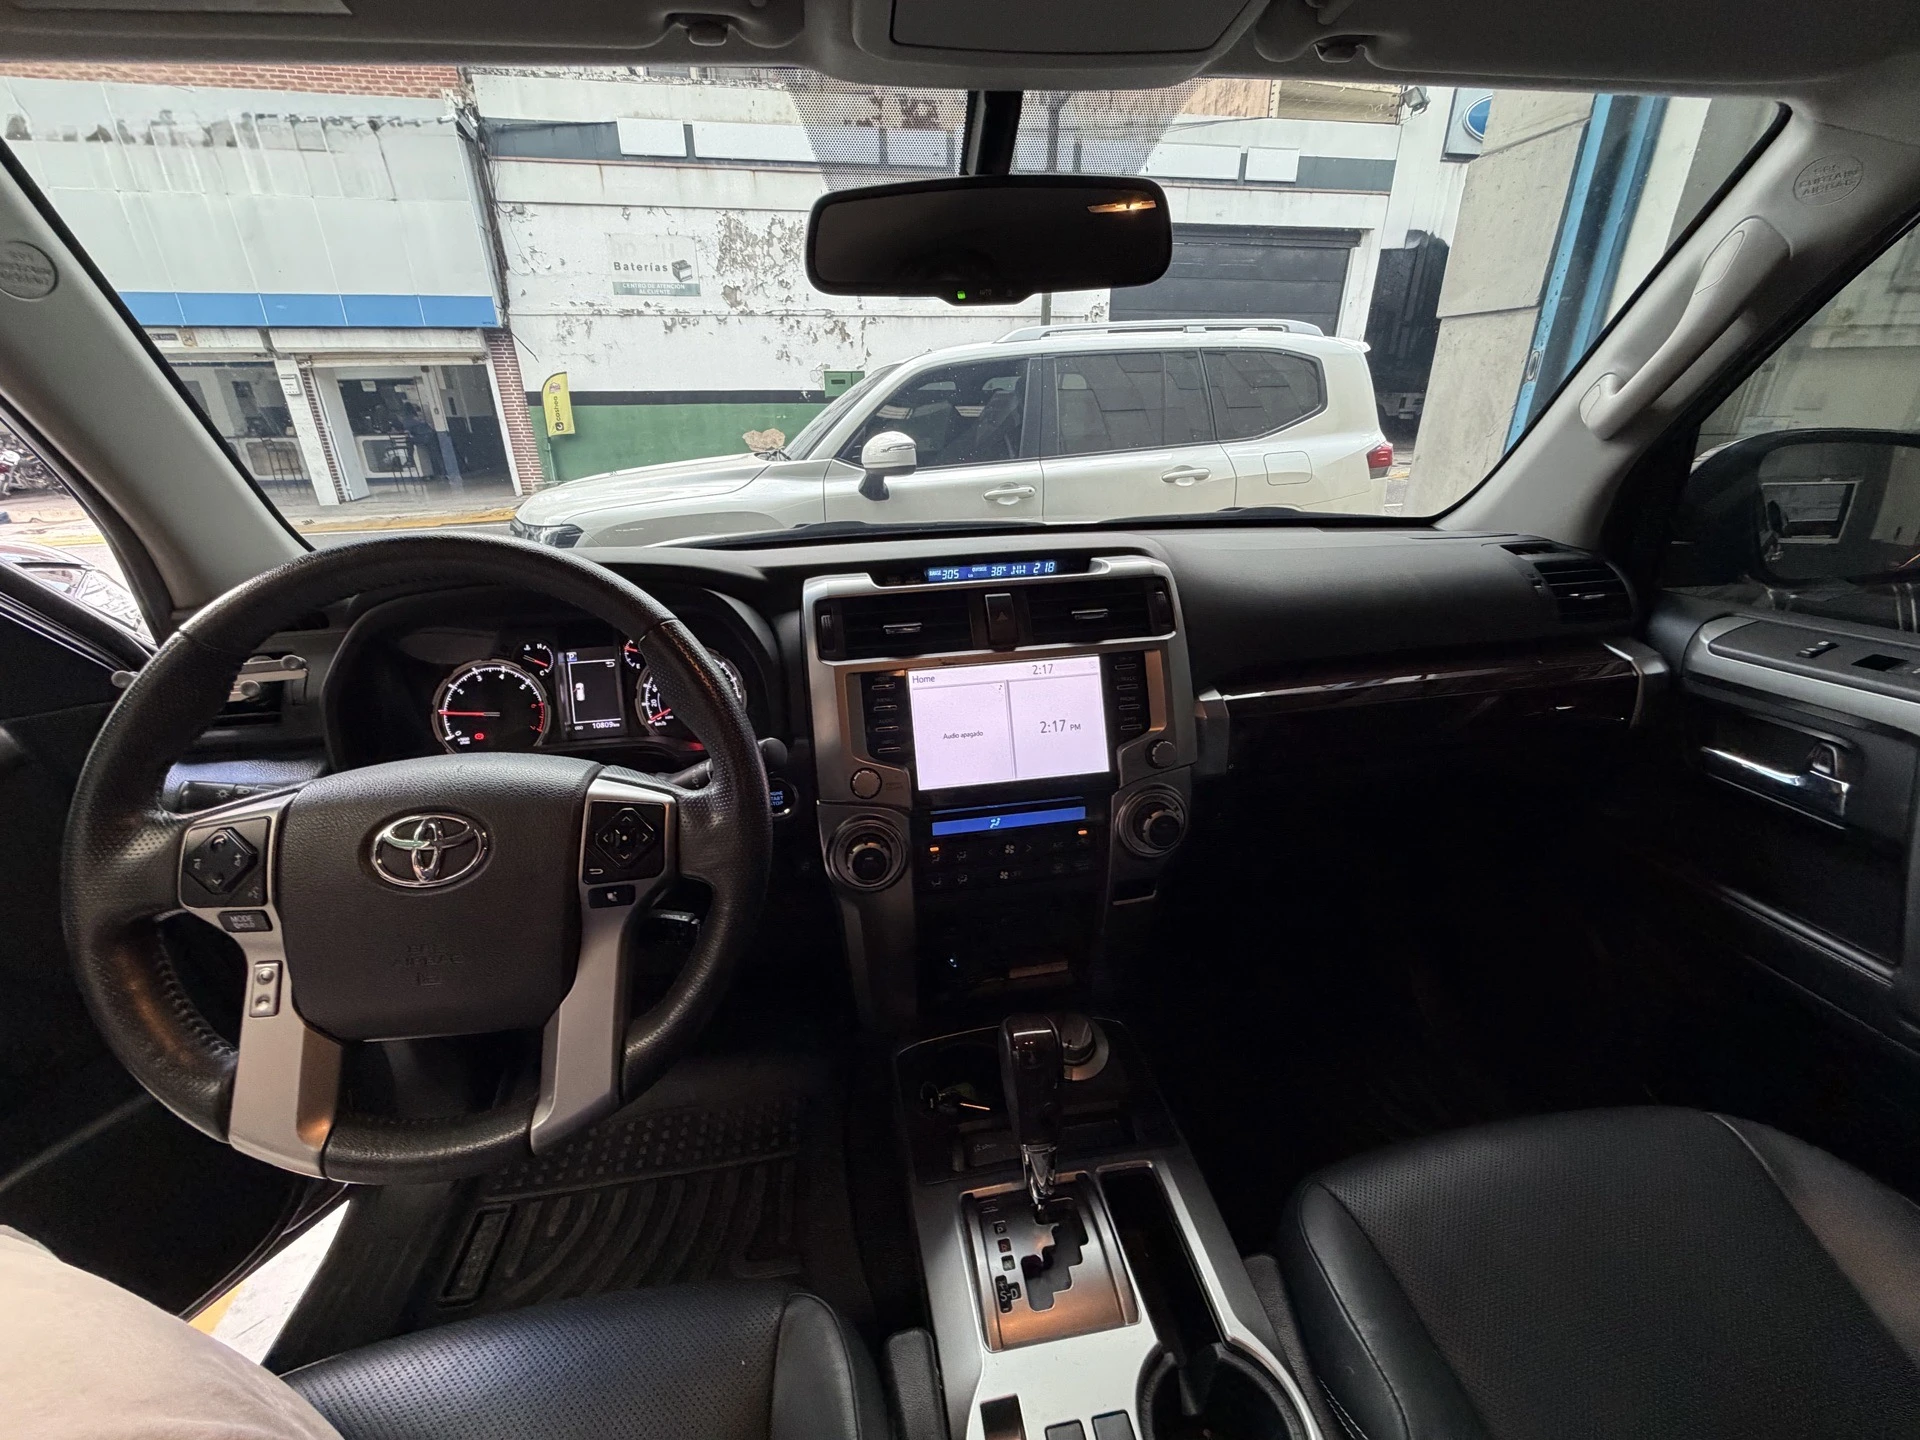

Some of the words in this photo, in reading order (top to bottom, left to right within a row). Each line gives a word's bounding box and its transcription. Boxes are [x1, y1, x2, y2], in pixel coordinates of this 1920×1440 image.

[942, 569, 959, 580] 305
[1032, 663, 1053, 675] 2:17
[912, 675, 935, 684] Home
[1040, 719, 1066, 734] 2:17
[1070, 723, 1081, 731] PM
[942, 732, 960, 740] Audio
[960, 730, 984, 739] apagado
